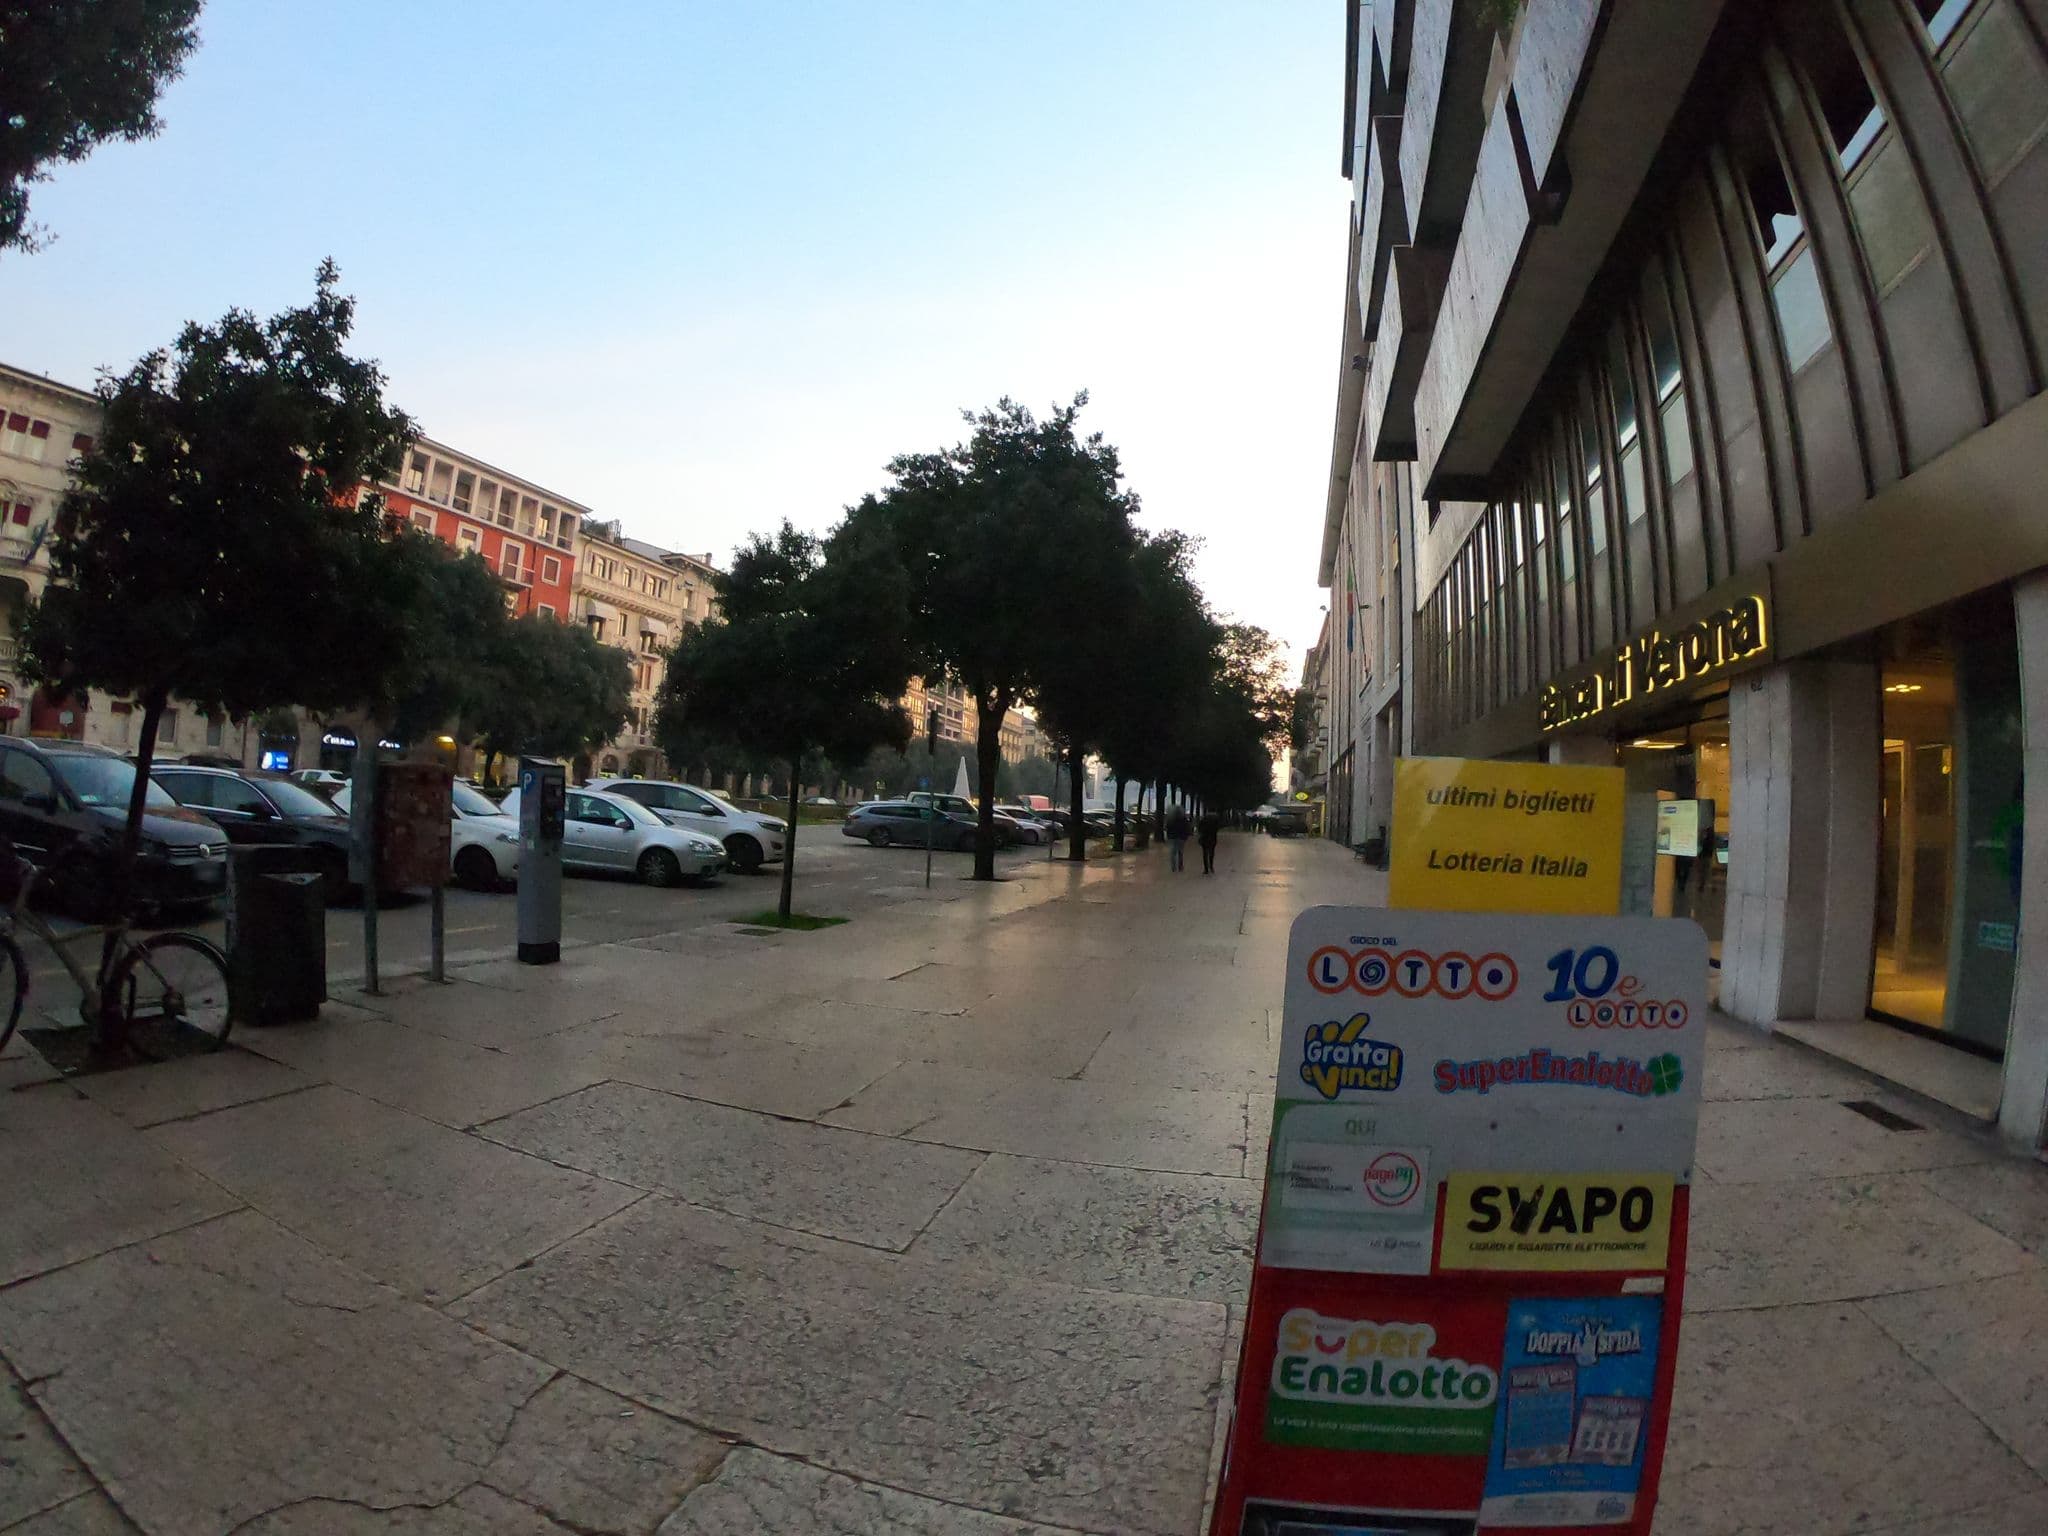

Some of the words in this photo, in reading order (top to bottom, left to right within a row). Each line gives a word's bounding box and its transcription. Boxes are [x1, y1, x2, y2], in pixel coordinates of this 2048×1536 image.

[1638, 593, 1769, 695] Verona
[1425, 787, 1496, 809] ultimi
[1503, 788, 1597, 816] biglietti
[1428, 849, 1525, 876] Lotteria
[1530, 856, 1590, 878] Italia
[1350, 936, 1380, 945] GIOCO
[1382, 937, 1398, 946] DEL
[1543, 945, 1619, 1002] 10
[1306, 1039, 1390, 1067] Gratta
[1433, 1048, 1653, 1096] SuperEnalotto
[1467, 1184, 1654, 1236] SVAPO
[1285, 1315, 1427, 1361] Super
[1526, 1330, 1582, 1355] DOPPIA
[1279, 1355, 1492, 1401] Enalotto
